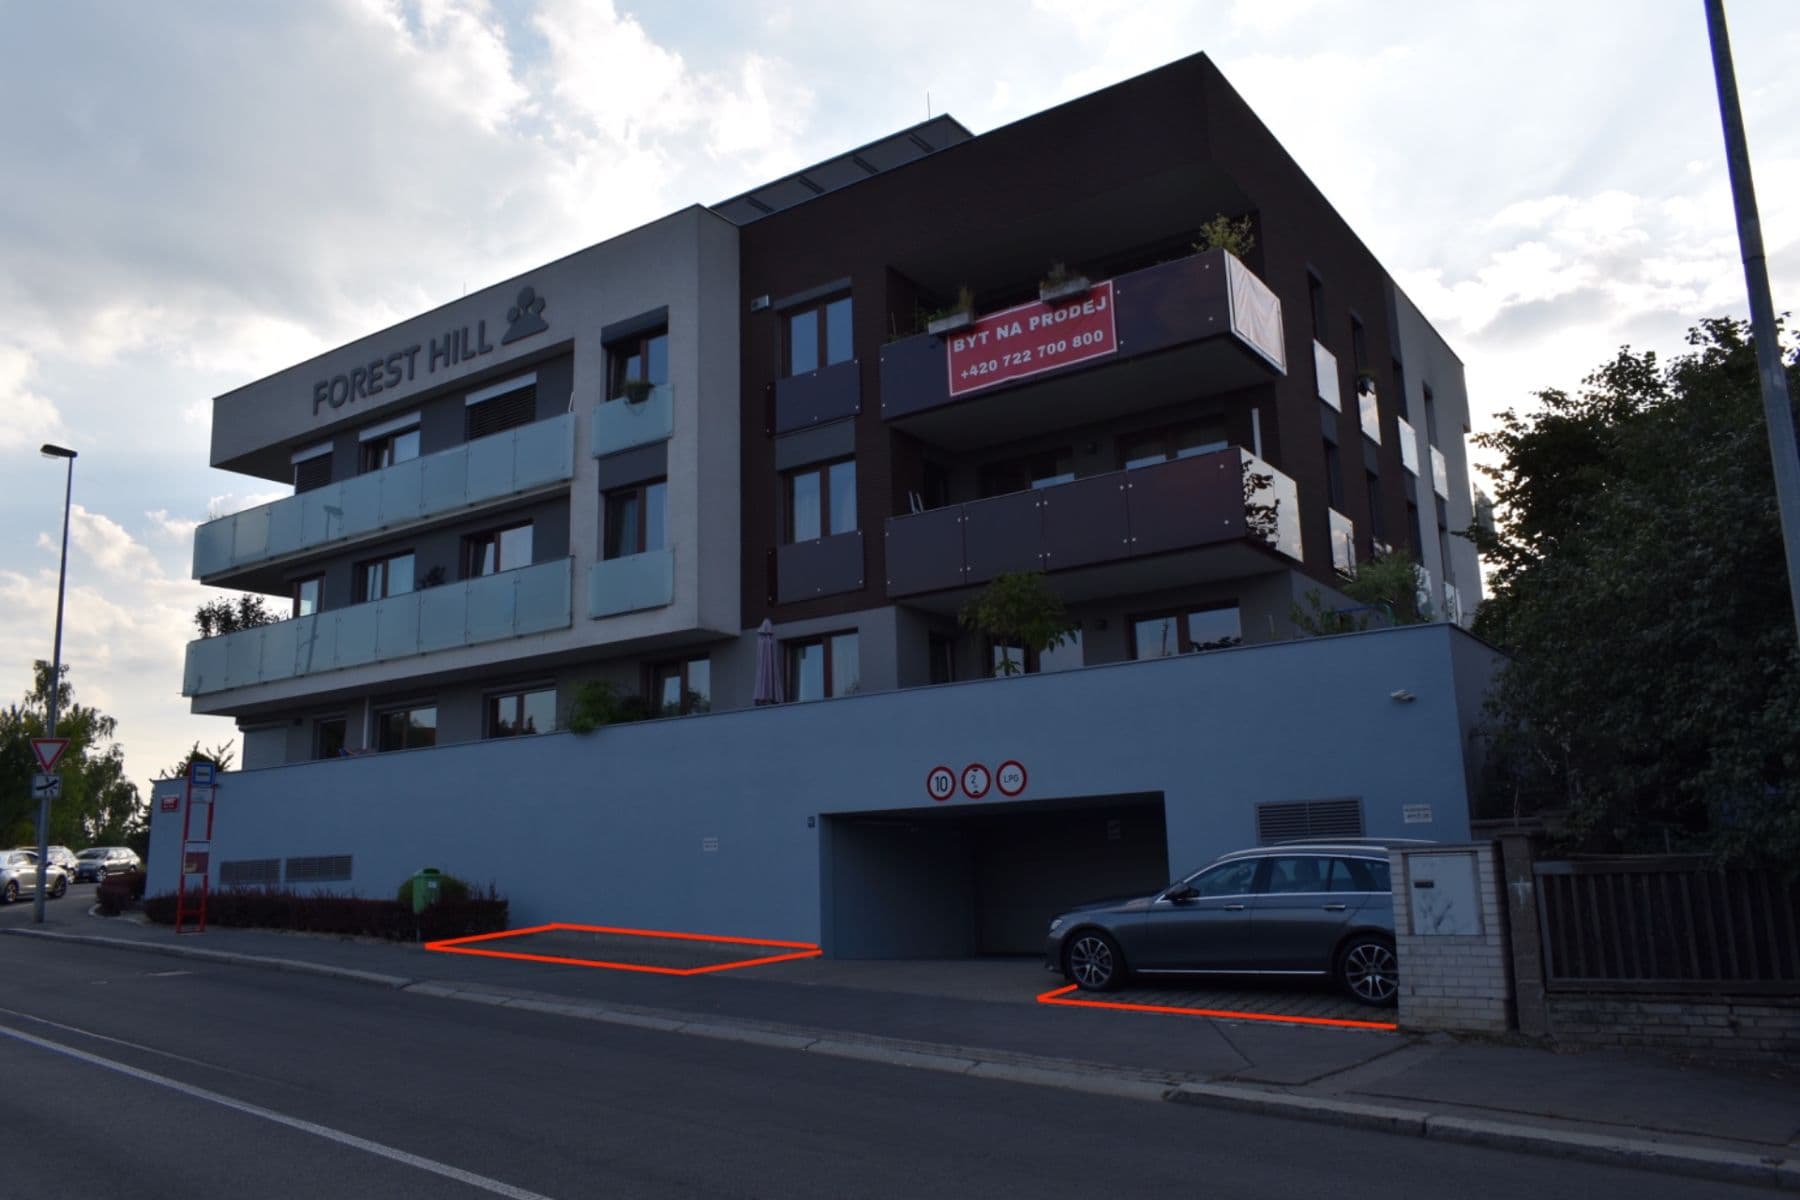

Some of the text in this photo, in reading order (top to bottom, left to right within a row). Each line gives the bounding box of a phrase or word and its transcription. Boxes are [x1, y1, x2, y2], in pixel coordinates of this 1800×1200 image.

[953, 295, 1107, 353] BYT NA PRODEJ
[312, 320, 494, 416] FOREST HILL
[960, 330, 1104, 379] +420 722 700 800
[935, 775, 948, 792] 10
[1003, 774, 1019, 784] LPG
